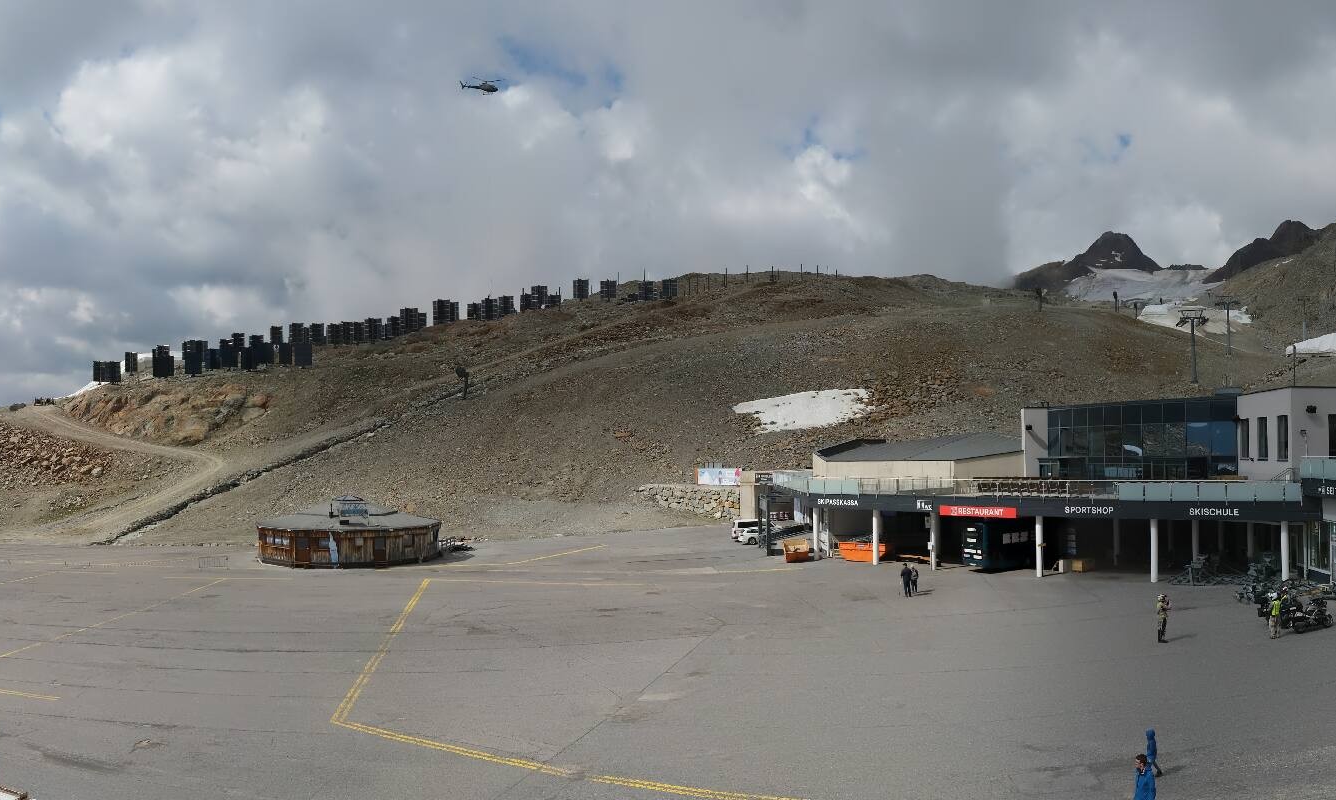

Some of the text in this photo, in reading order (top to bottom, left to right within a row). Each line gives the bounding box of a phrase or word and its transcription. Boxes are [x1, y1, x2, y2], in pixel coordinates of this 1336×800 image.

[958, 507, 1004, 516] RESTAURANT
[1064, 506, 1114, 515] SPORTSHOP
[1189, 508, 1240, 516] SKISCHULE
